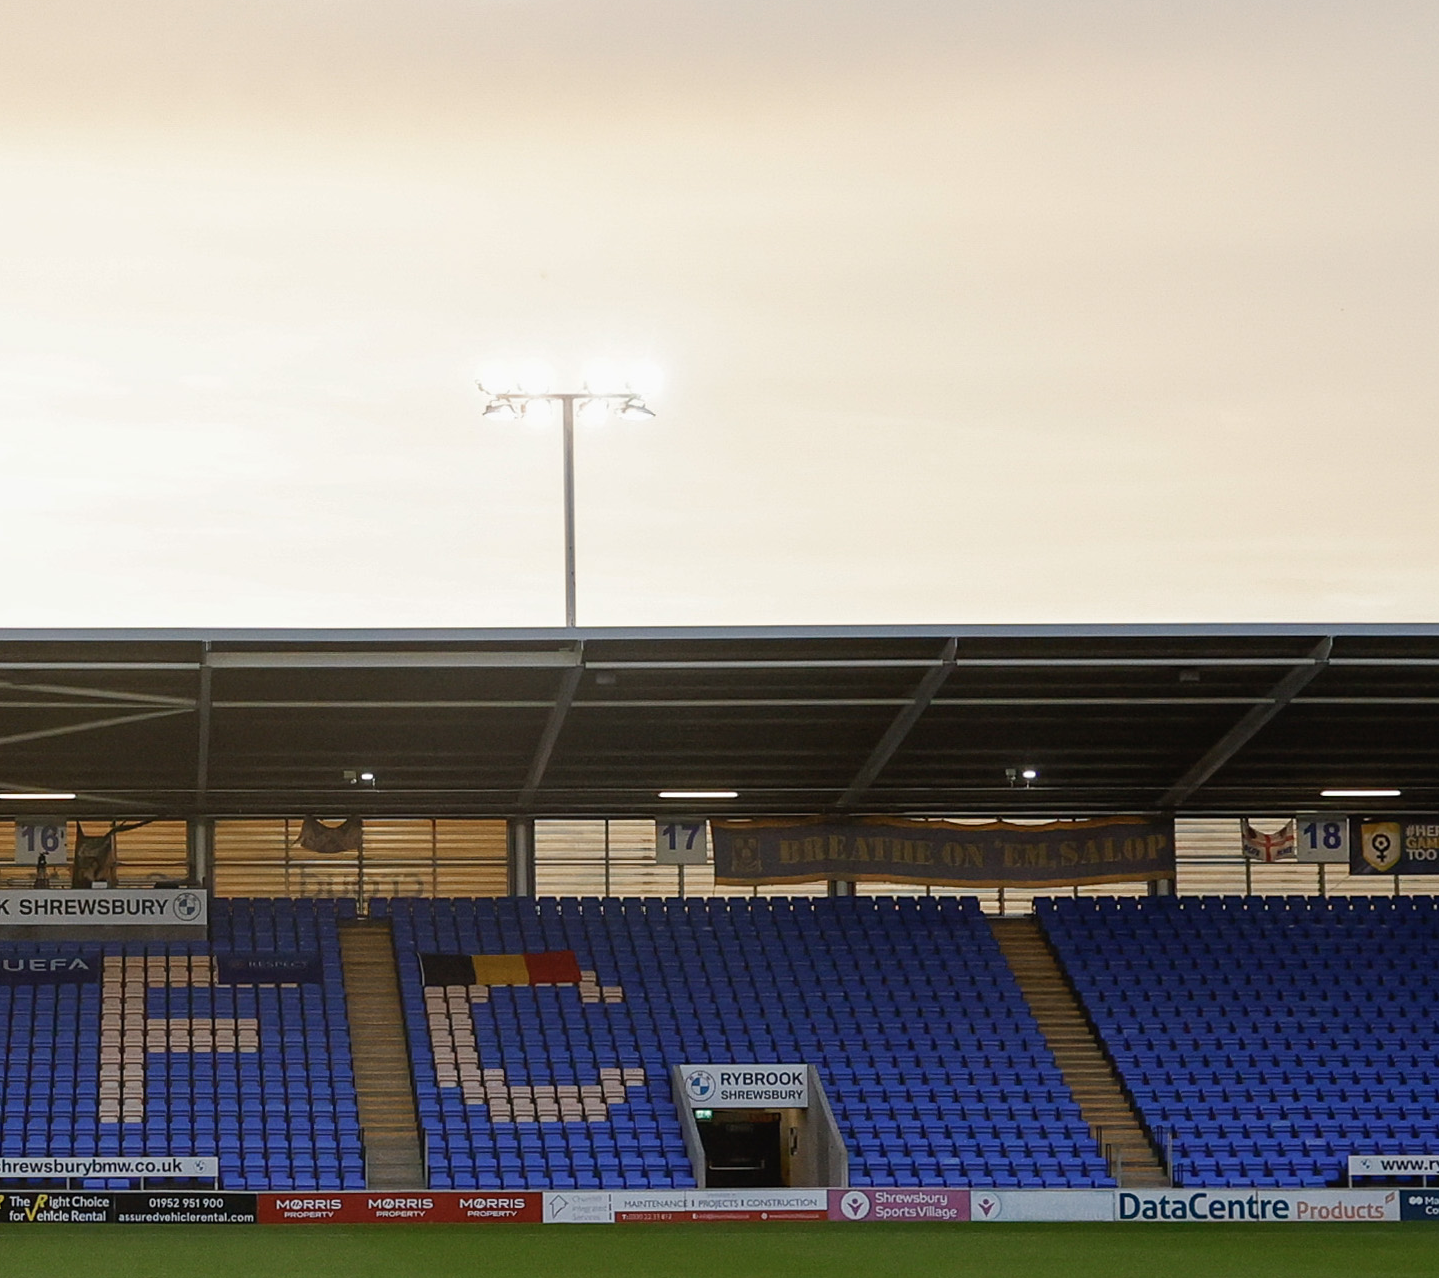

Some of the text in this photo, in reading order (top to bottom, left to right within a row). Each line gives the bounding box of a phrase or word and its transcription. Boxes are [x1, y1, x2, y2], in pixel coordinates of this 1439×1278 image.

[21, 825, 59, 853] 16
[660, 824, 701, 851] 17
[1303, 822, 1342, 849] 18
[779, 833, 934, 866] BREATHE
[943, 841, 984, 868] ON
[1059, 834, 1167, 866] SALOP
[1405, 848, 1438, 861] TOO
[18, 898, 169, 917] SHREWSBURY
[2, 958, 90, 972] UEFA
[720, 1072, 803, 1085] RYBROOK
[720, 1090, 803, 1100] SHREWSBURY
[8, 1196, 31, 1208] The
[71, 1196, 110, 1208] Choice
[148, 1198, 224, 1210] 01952 951 900
[275, 1198, 343, 1210] MORRIS
[367, 1197, 434, 1210] MORRIS
[459, 1197, 526, 1209] MORRIS
[624, 1198, 818, 1209] MAINTENANCE PROJECTS CONSTRUCTION
[875, 1192, 949, 1206] Shrewsbury
[1118, 1192, 1385, 1220] DataCentre Products
[9, 1209, 25, 1221] for
[71, 1209, 107, 1222] Rental
[117, 1212, 255, 1224] assuredvehiclerental.com
[283, 1211, 334, 1219] PROPERTY
[375, 1210, 427, 1218] PROPERTY
[466, 1210, 518, 1218] PROPERTY
